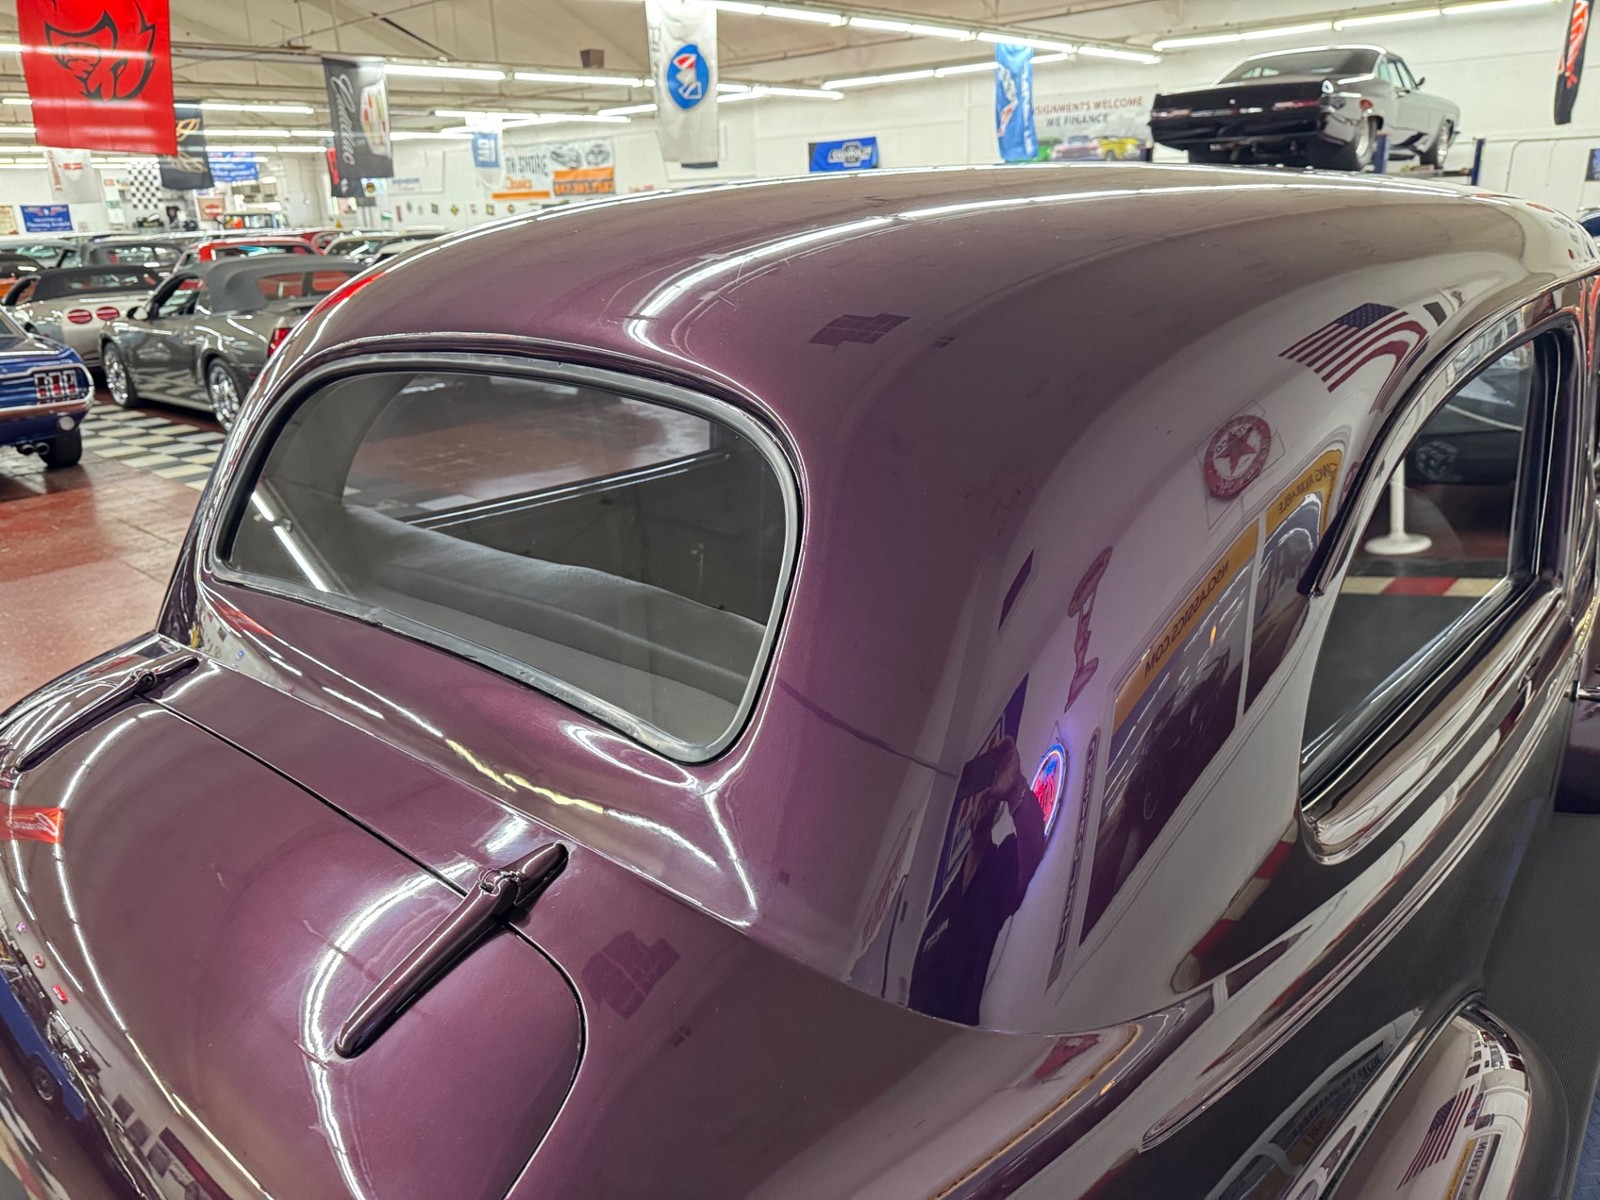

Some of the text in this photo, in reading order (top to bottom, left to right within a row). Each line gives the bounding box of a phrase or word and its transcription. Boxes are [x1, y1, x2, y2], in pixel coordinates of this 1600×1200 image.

[1034, 96, 1143, 116] SIGNMENTS WELCOME
[1046, 112, 1108, 128] WE FINANCE
